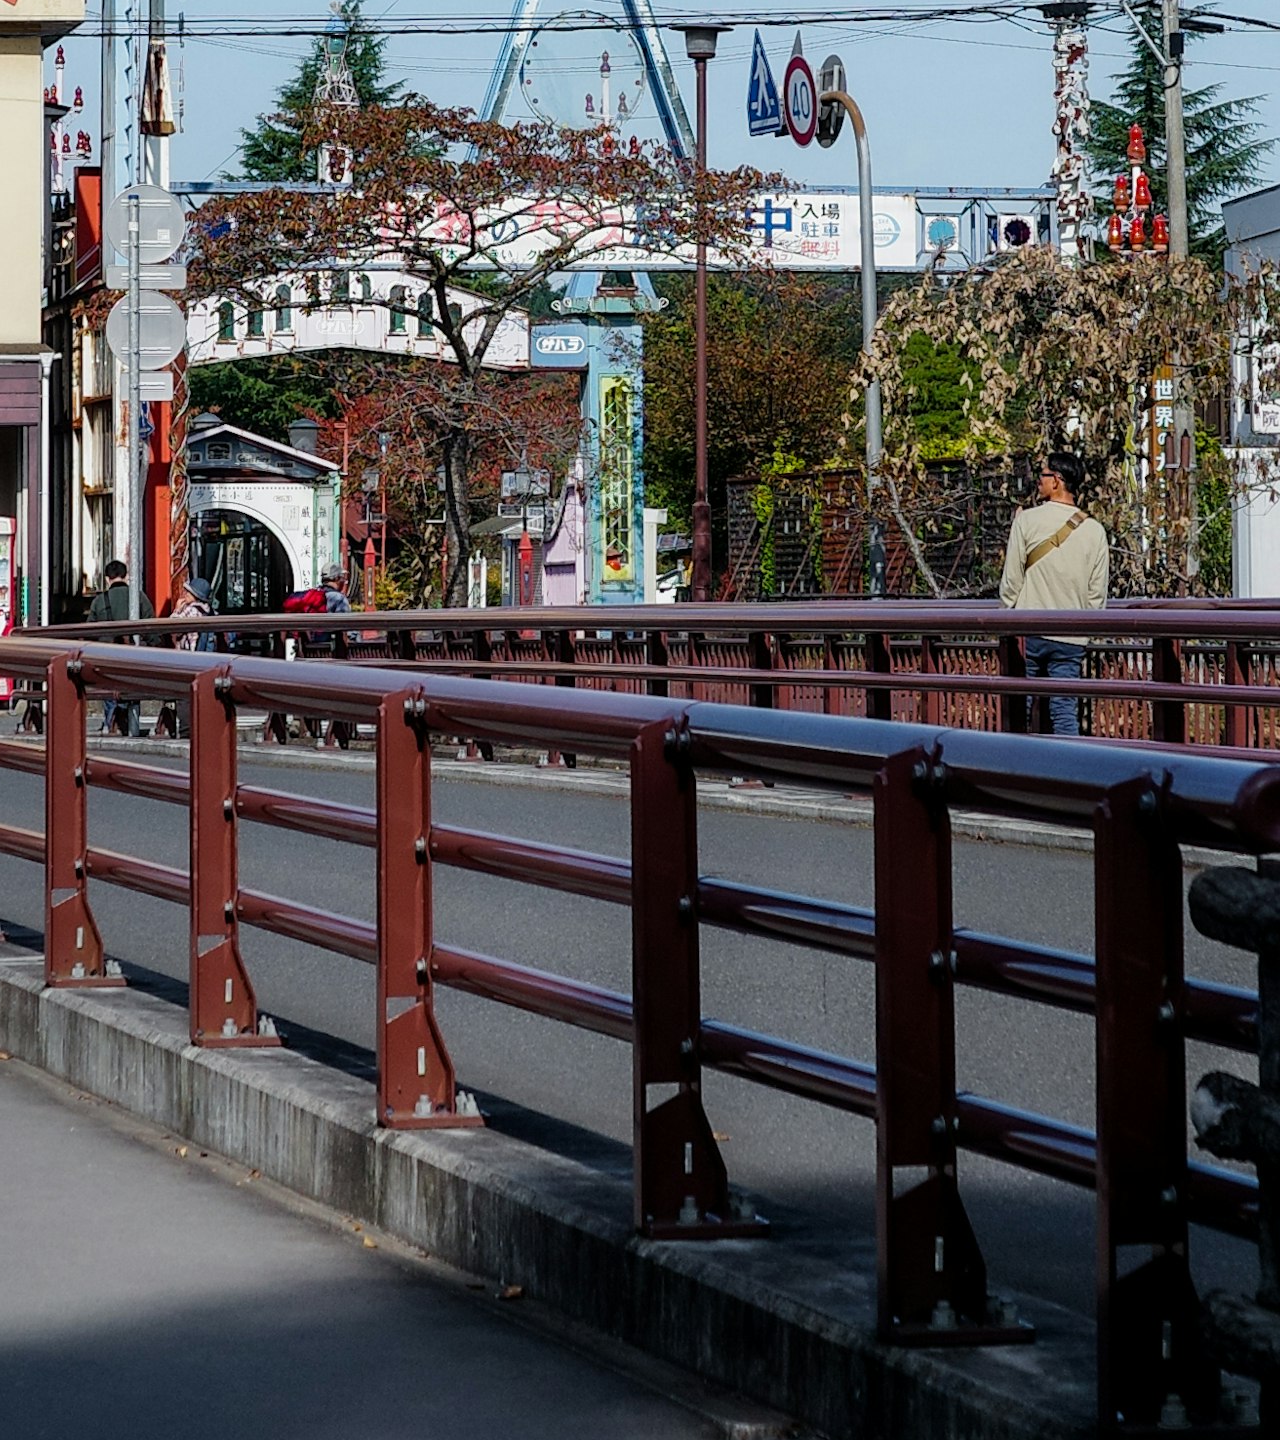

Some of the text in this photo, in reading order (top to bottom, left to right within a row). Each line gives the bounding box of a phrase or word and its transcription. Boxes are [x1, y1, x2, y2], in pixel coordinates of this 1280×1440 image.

[793, 81, 810, 120] 40
[801, 203, 840, 220] 入場
[801, 222, 840, 238] 駐車
[541, 338, 580, 352] サハラ
